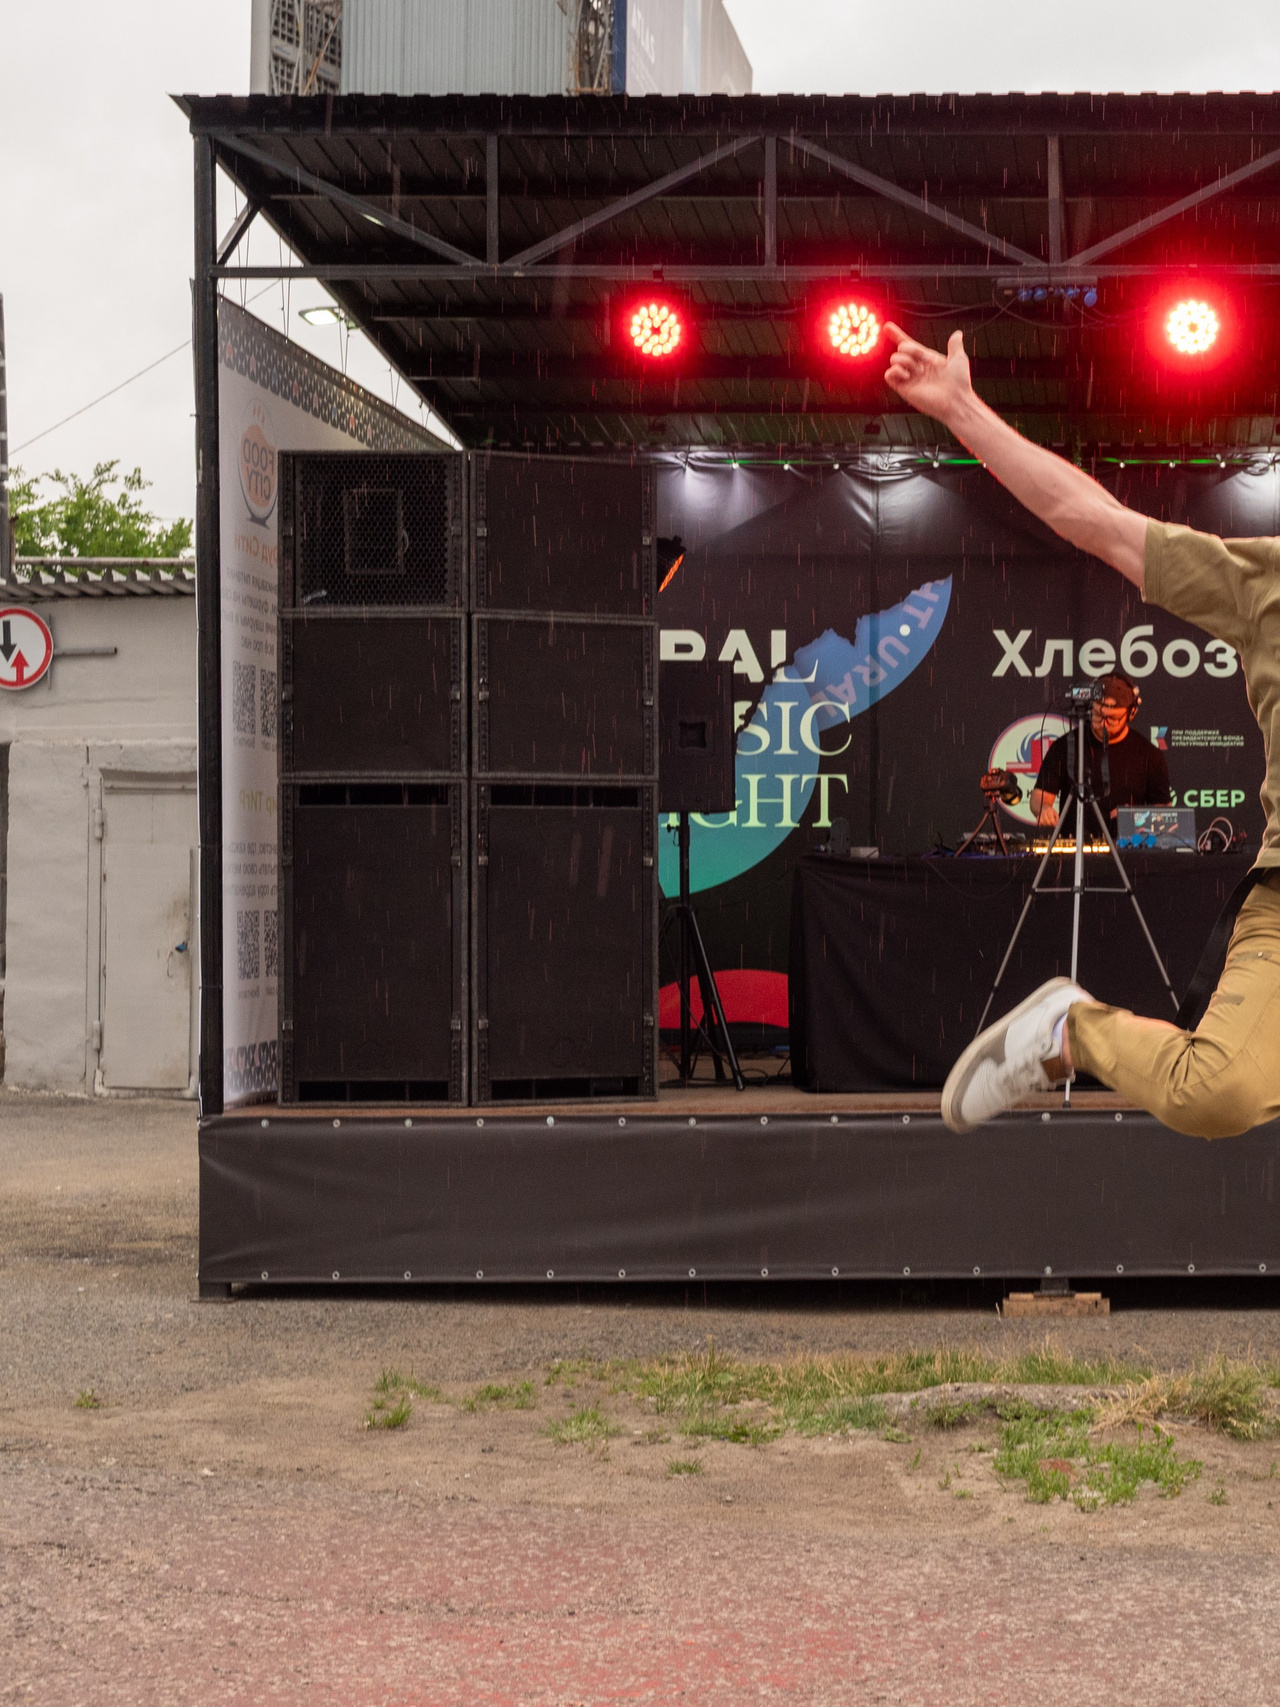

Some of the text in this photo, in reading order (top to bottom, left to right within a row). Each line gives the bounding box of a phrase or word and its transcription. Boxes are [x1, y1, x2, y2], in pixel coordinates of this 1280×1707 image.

[659, 629, 818, 683] RAL
[991, 625, 1238, 678] Хлебоз
[734, 700, 852, 756] SIC
[1183, 789, 1246, 808] СБЕР
